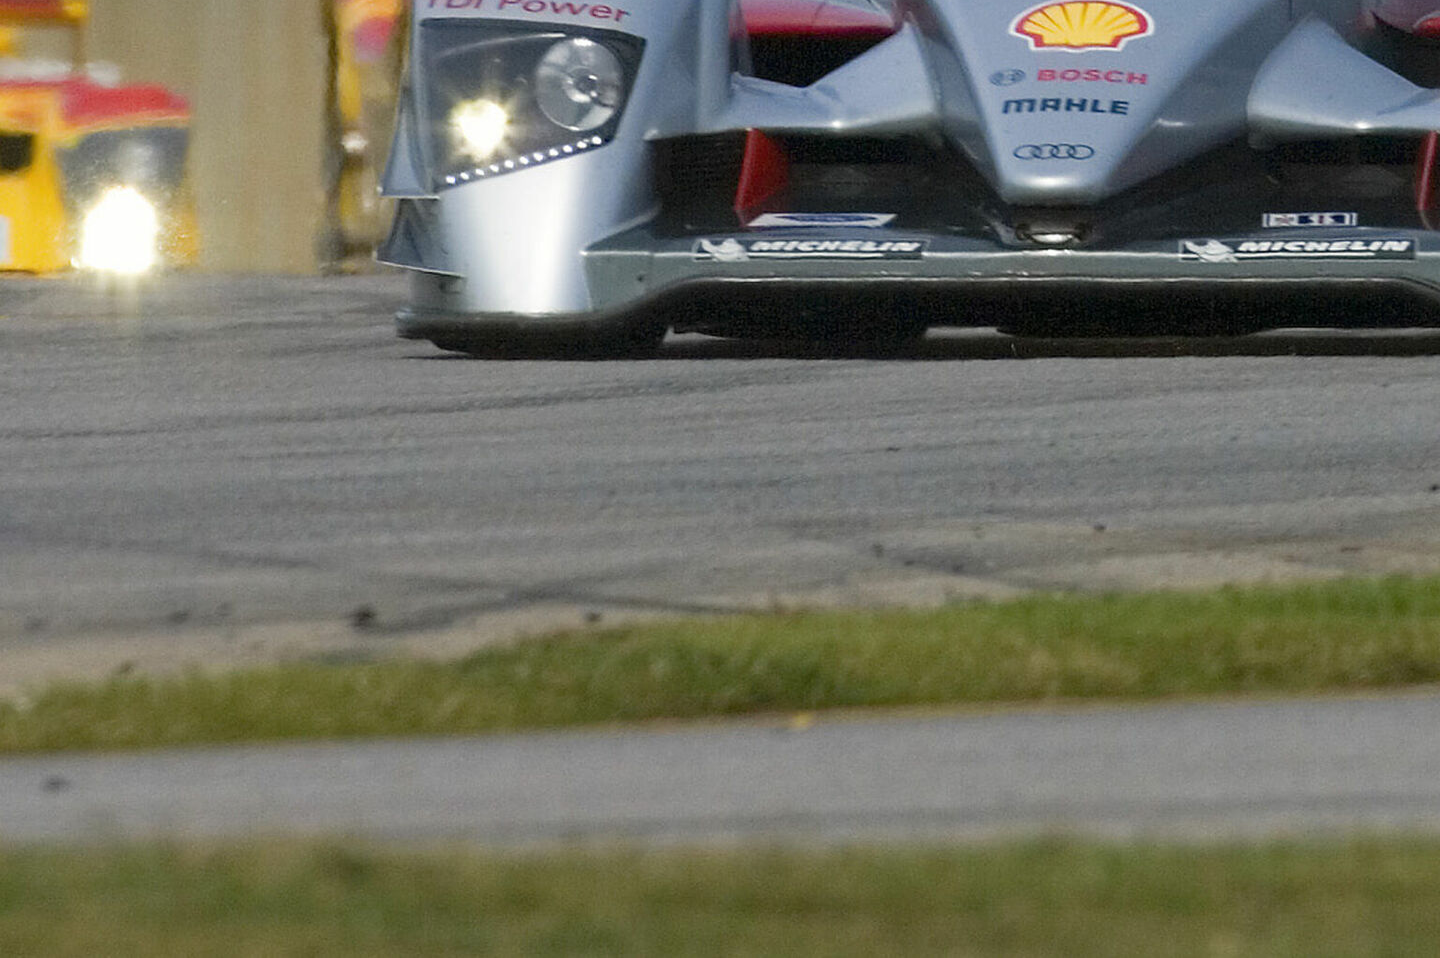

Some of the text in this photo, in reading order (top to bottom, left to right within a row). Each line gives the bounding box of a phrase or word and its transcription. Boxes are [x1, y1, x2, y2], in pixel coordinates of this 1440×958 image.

[1037, 68, 1149, 85] BOSCH
[1002, 97, 1130, 116] MAHLE
[751, 240, 922, 252] MICHELIN
[1238, 241, 1411, 252] MICHELIN
